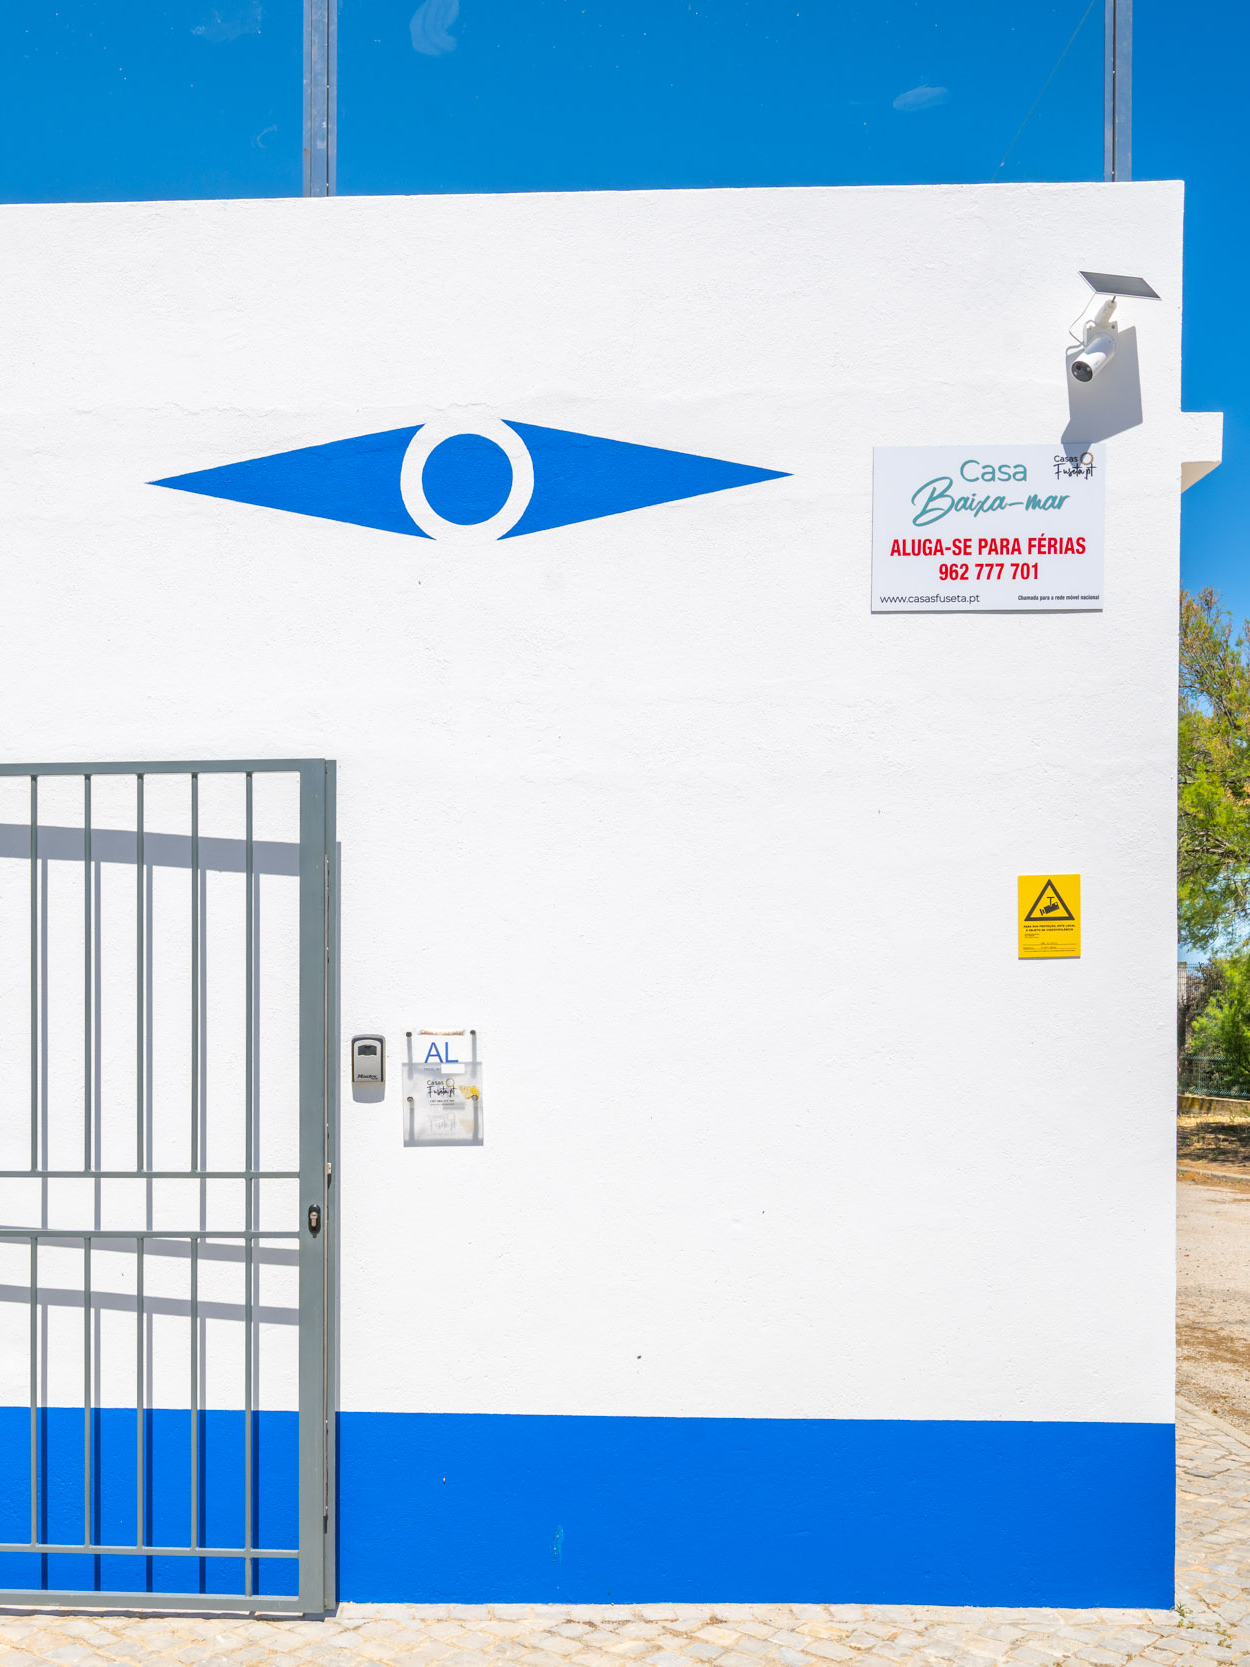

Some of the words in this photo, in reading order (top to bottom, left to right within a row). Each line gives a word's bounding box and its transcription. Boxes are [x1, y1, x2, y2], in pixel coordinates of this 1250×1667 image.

[1053, 454, 1079, 463] Casas
[960, 459, 1027, 482] Casa
[911, 476, 1070, 527] Baixa-mar
[890, 538, 972, 556] ALUGA-SE
[978, 537, 1022, 555] PARA
[1027, 533, 1086, 555] FÉRIAS
[939, 563, 969, 581] 962
[974, 563, 1005, 580] 777
[1010, 562, 1039, 580] 701
[879, 594, 980, 604] www.casasfuseta.pt
[424, 1042, 459, 1063] AL
